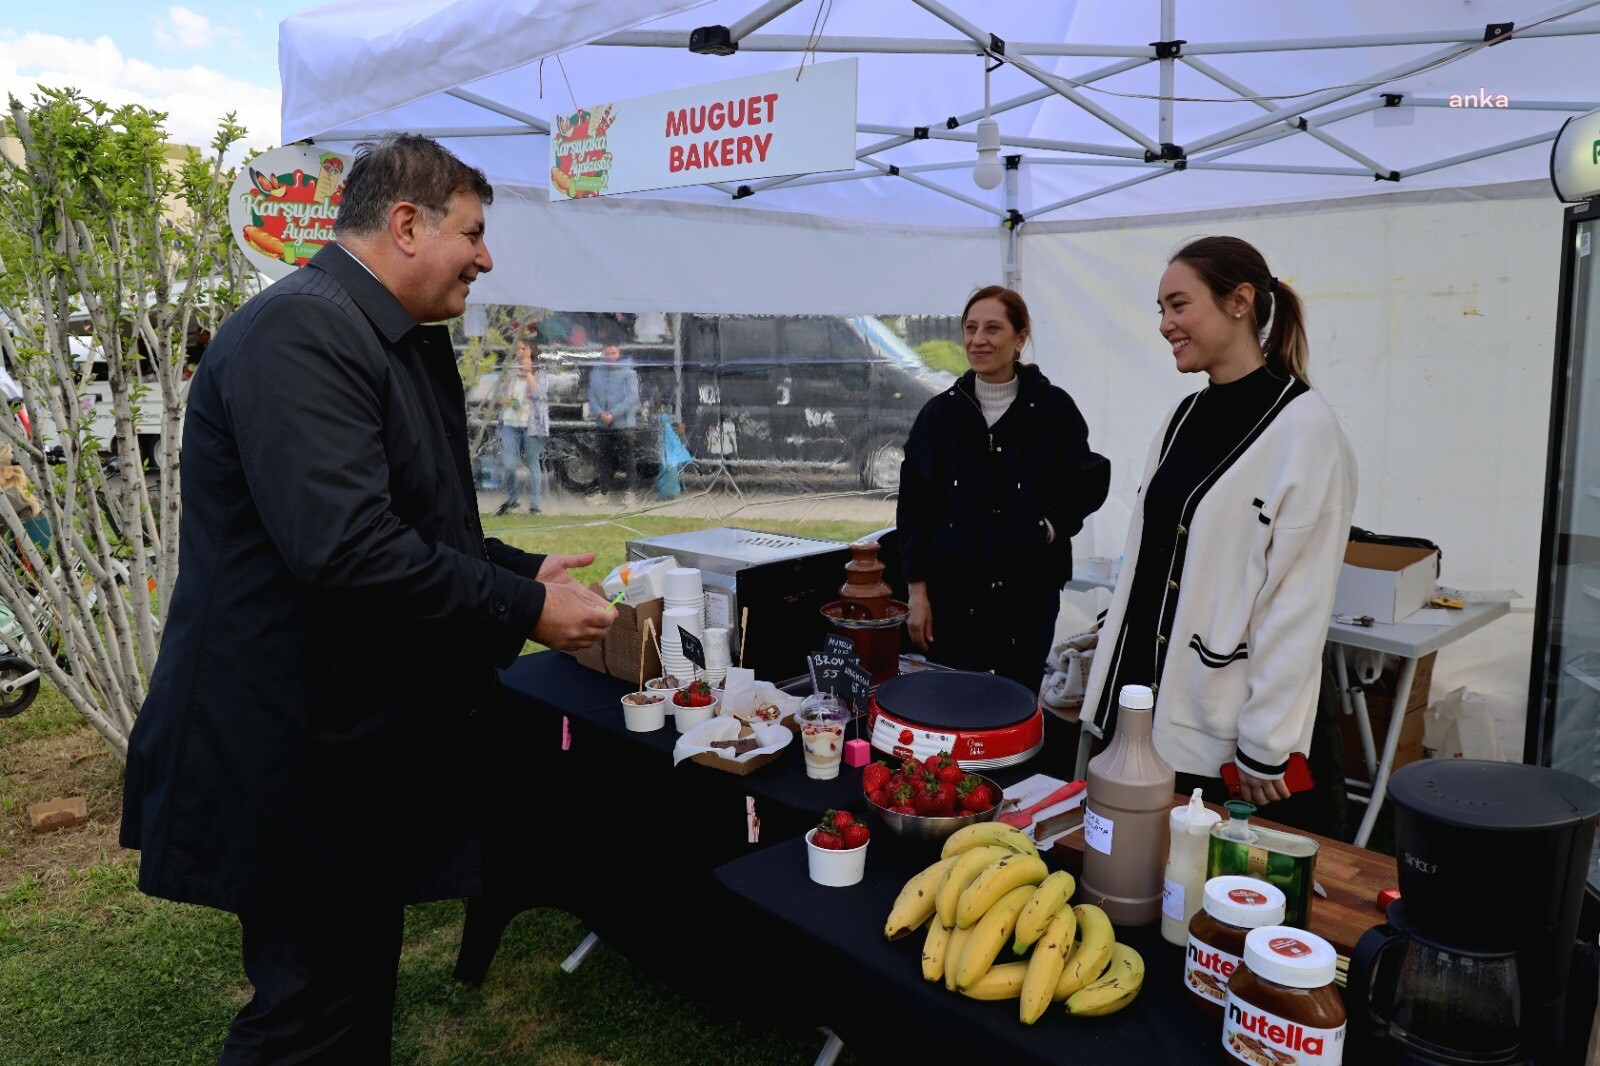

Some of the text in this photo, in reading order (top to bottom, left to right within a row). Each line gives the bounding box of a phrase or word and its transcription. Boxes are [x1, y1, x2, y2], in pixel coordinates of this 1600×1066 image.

[665, 93, 779, 138] MUGUET
[669, 132, 773, 173] BAKERY
[1188, 941, 1245, 979] nute
[1229, 1002, 1324, 1057] nutella
